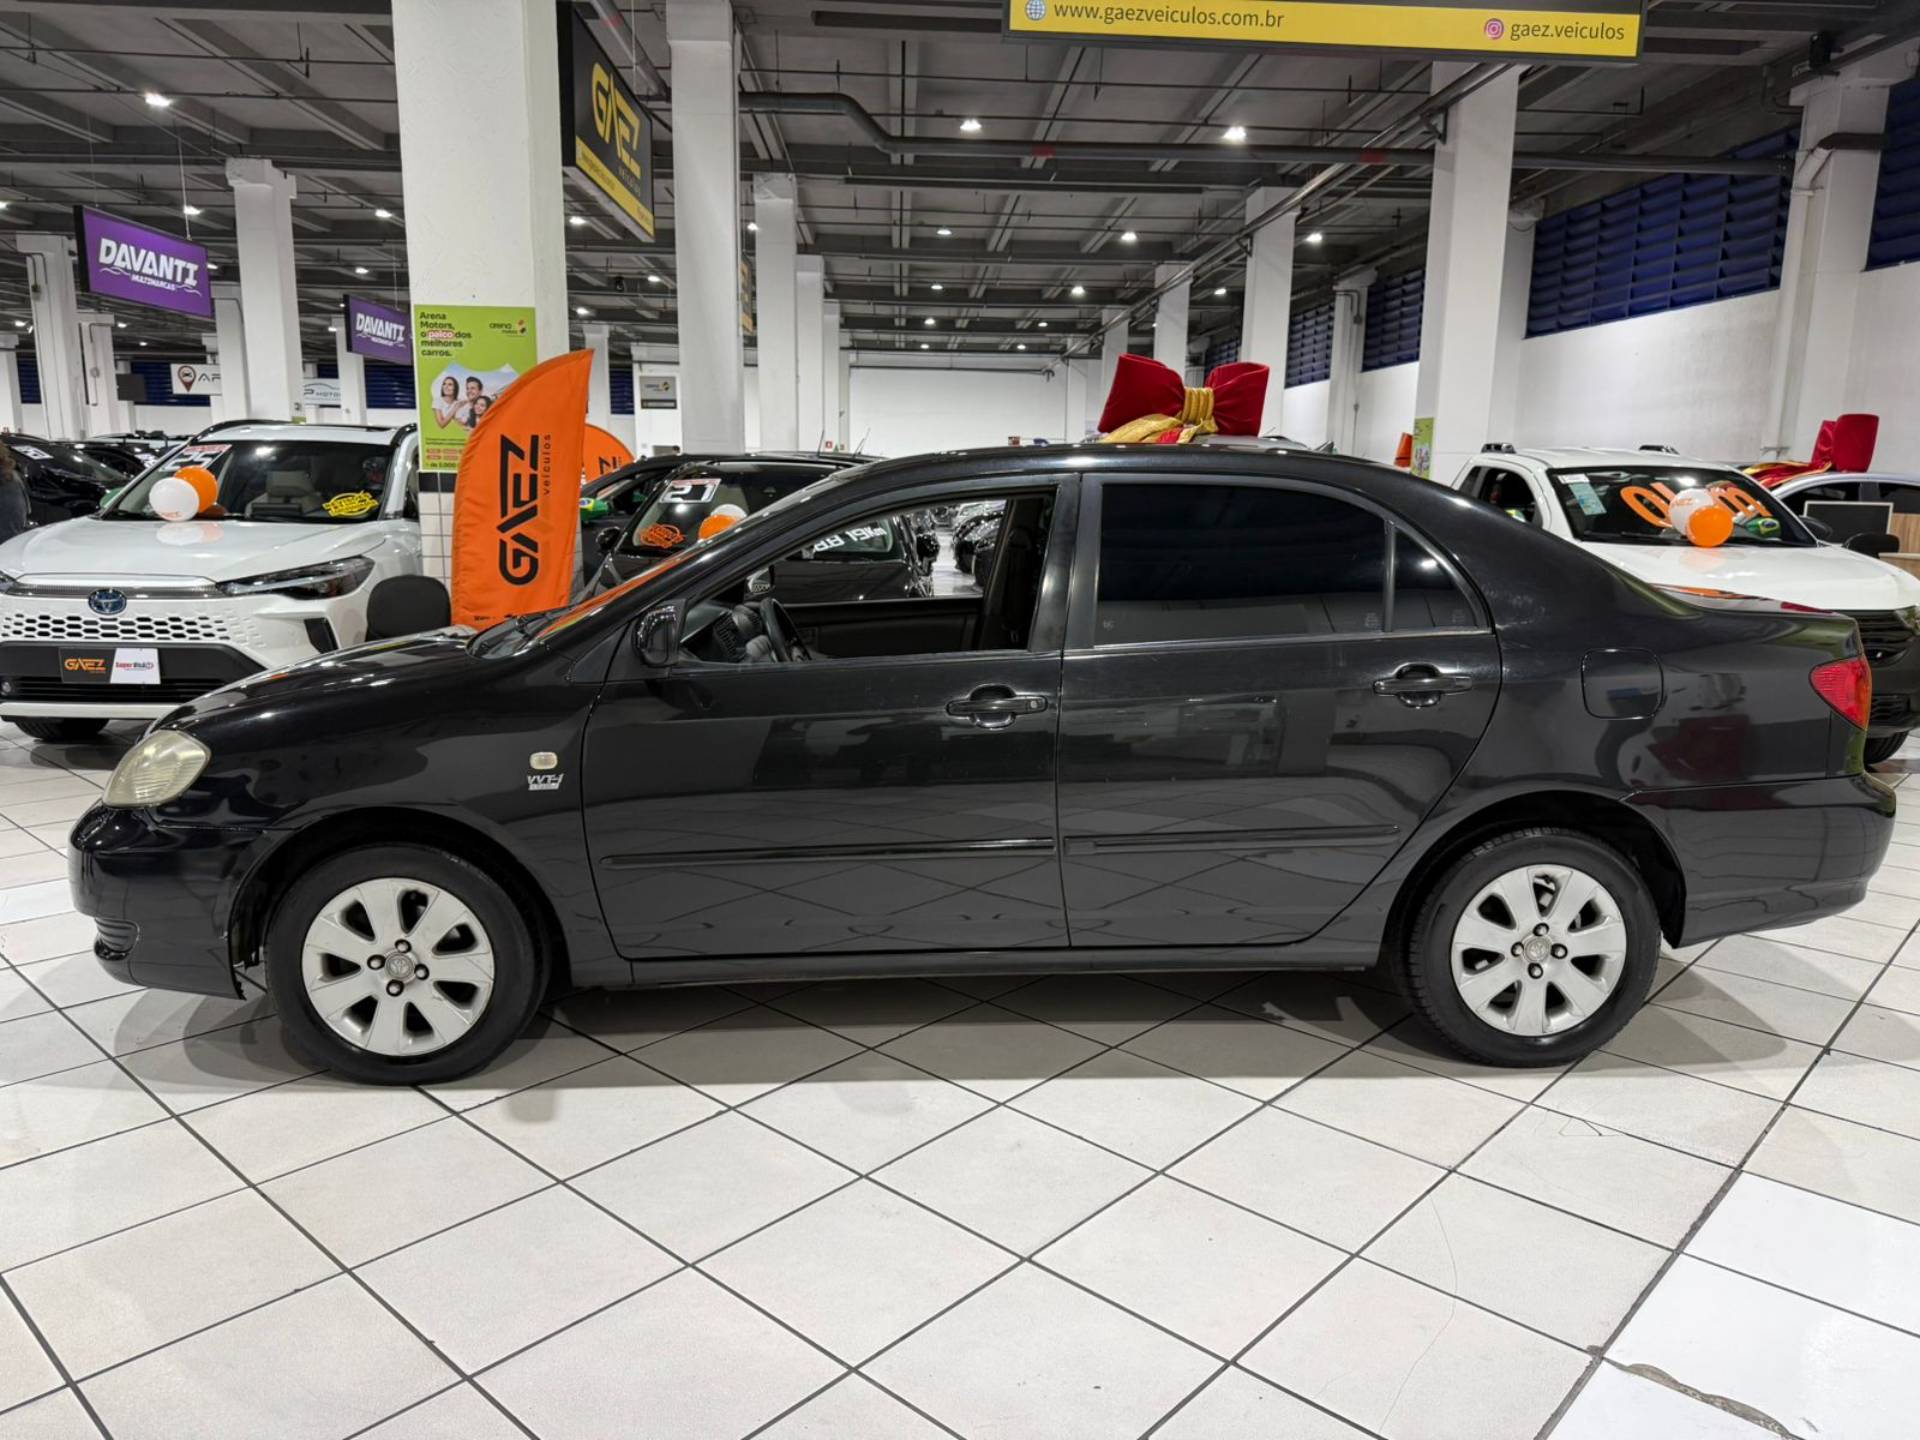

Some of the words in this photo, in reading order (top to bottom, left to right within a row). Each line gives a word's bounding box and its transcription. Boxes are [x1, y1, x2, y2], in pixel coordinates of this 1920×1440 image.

[1053, 2, 1285, 28] www.gaezveiculos.com.br
[1510, 22, 1625, 41] gaez.veiculos
[99, 237, 199, 286] DAVANTI
[420, 312, 447, 320] Arena
[356, 312, 405, 343] DAVANTI
[421, 339, 463, 347] melhores
[421, 349, 452, 357] carros.
[496, 434, 540, 586] GAEZ
[64, 658, 106, 671] GAEZ
